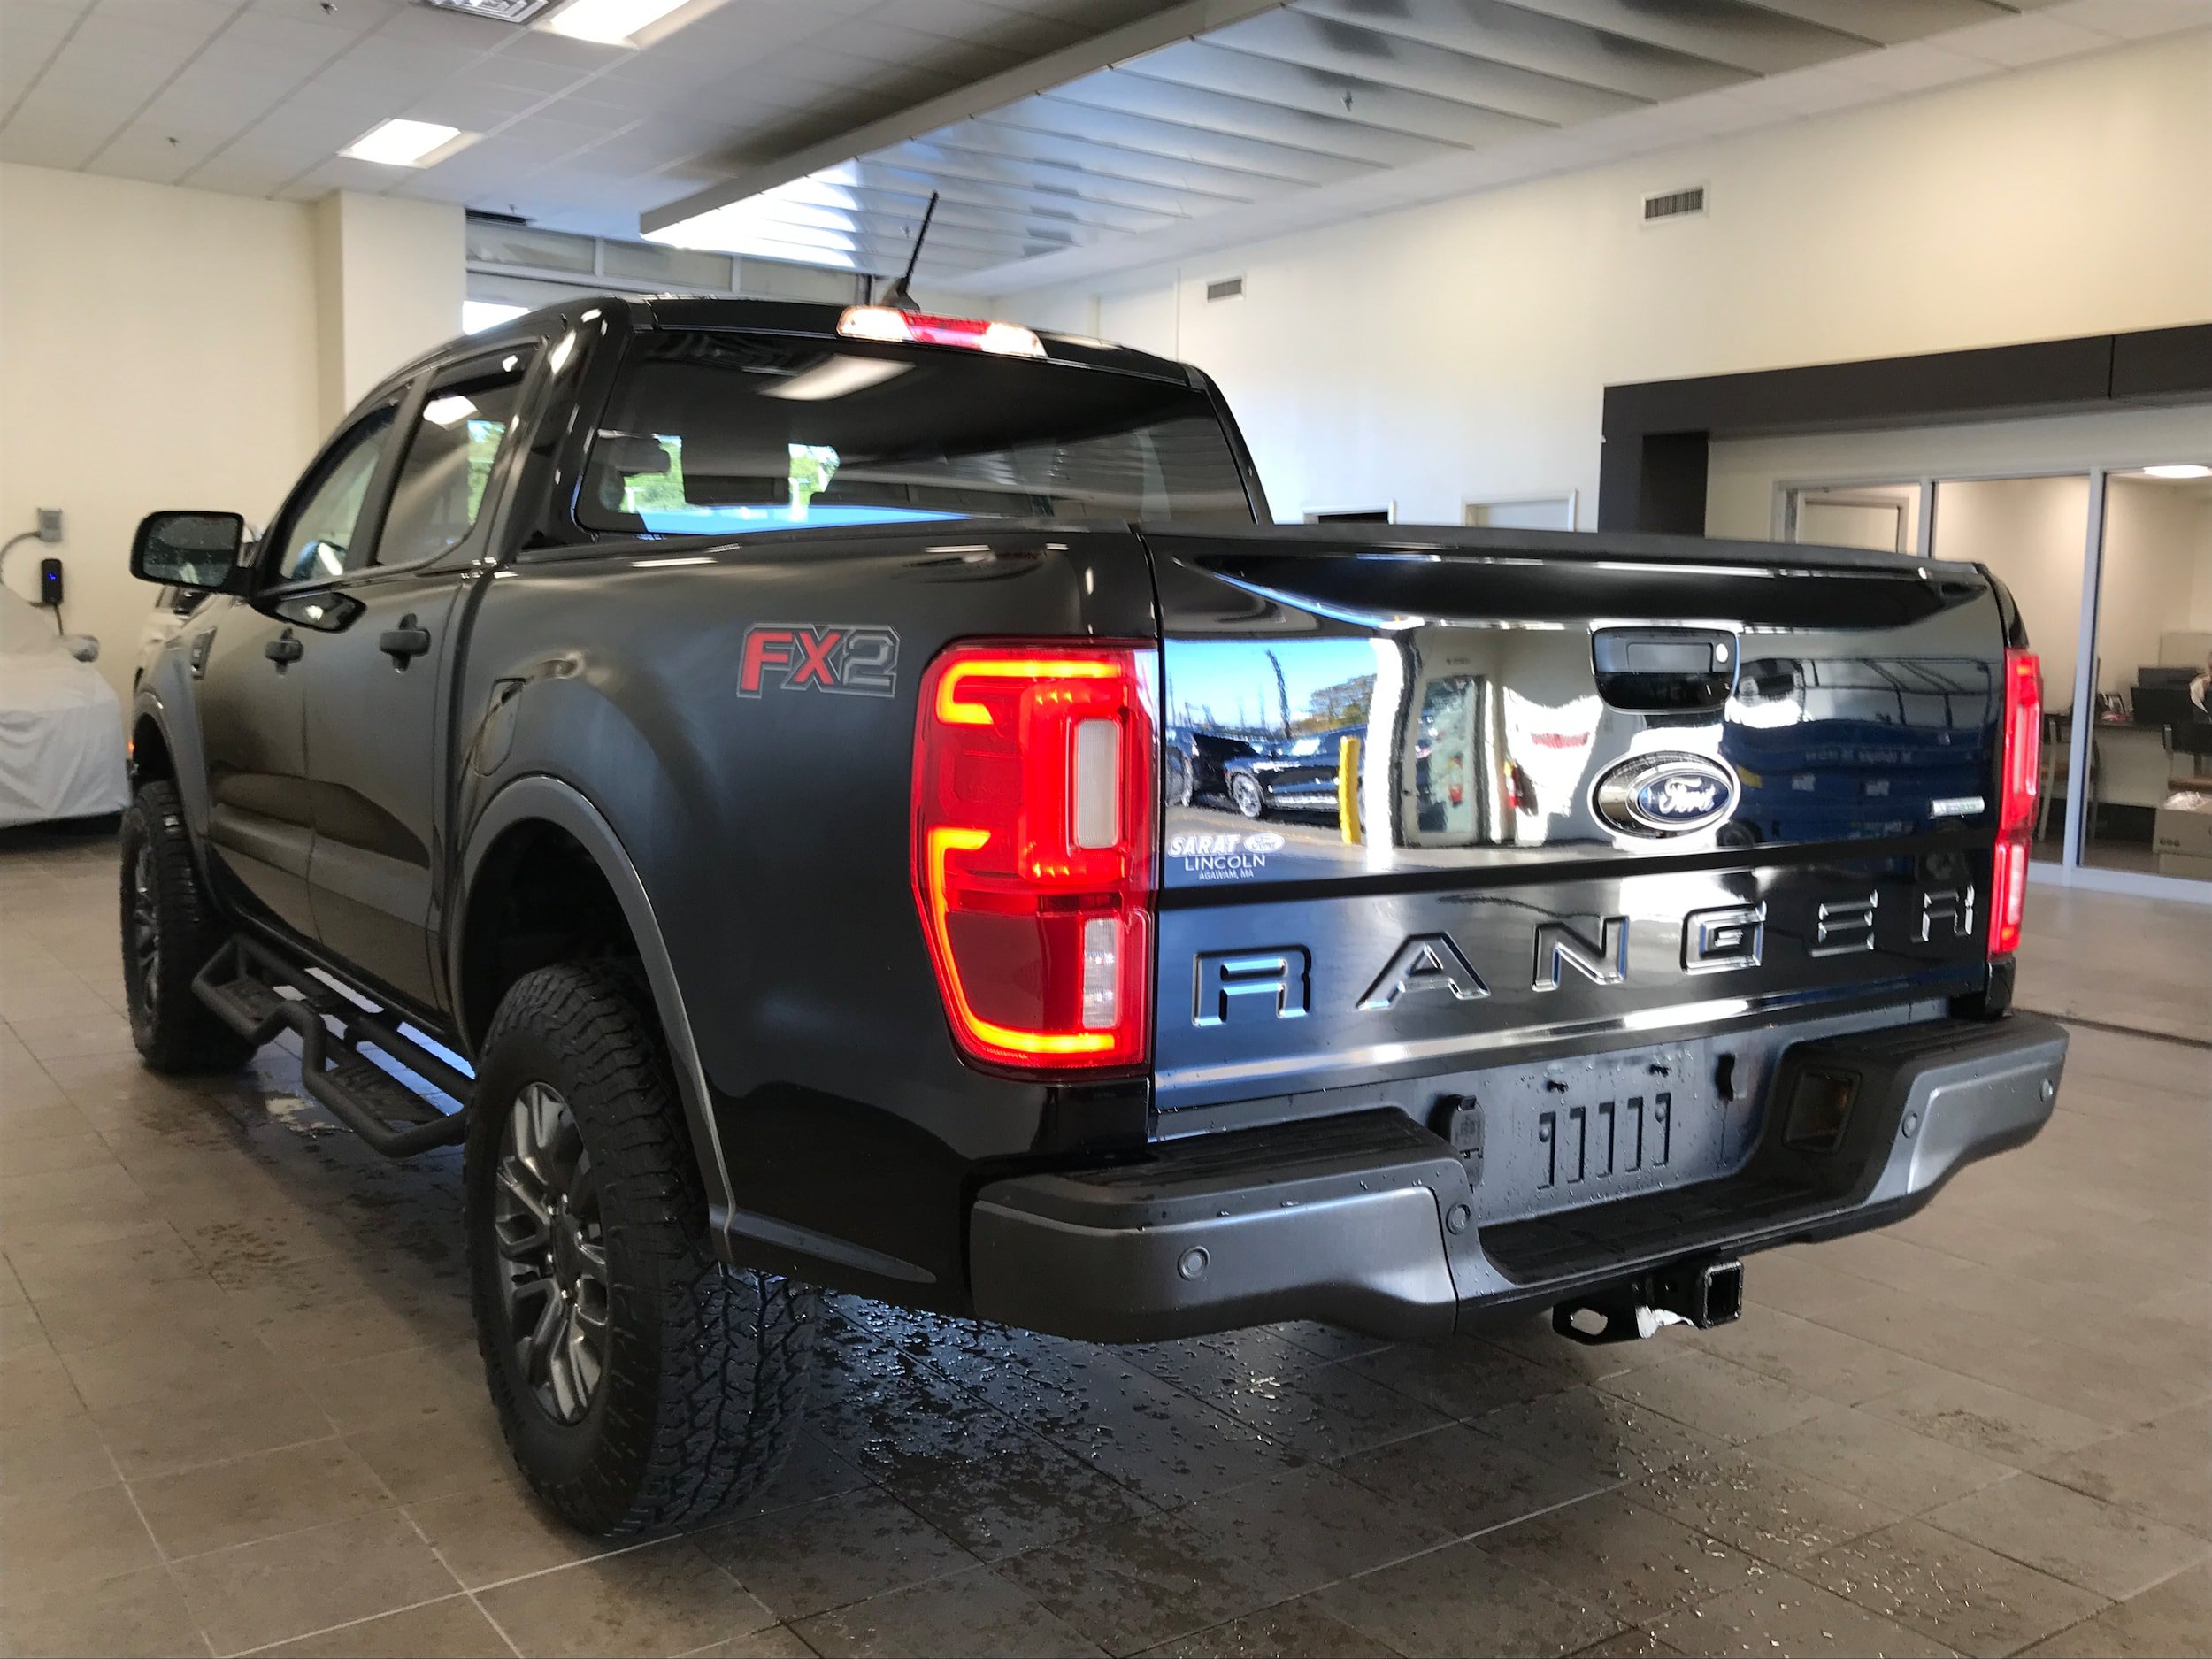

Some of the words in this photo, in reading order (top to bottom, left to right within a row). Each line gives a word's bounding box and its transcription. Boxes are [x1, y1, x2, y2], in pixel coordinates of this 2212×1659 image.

[736, 623, 901, 698] FX2
[1658, 777, 1716, 815] Ford
[1168, 834, 1240, 857] SARAT
[1185, 855, 1265, 872] LINCOLN
[1240, 870, 1254, 879] MA
[1192, 883, 1975, 1027] RANGER
